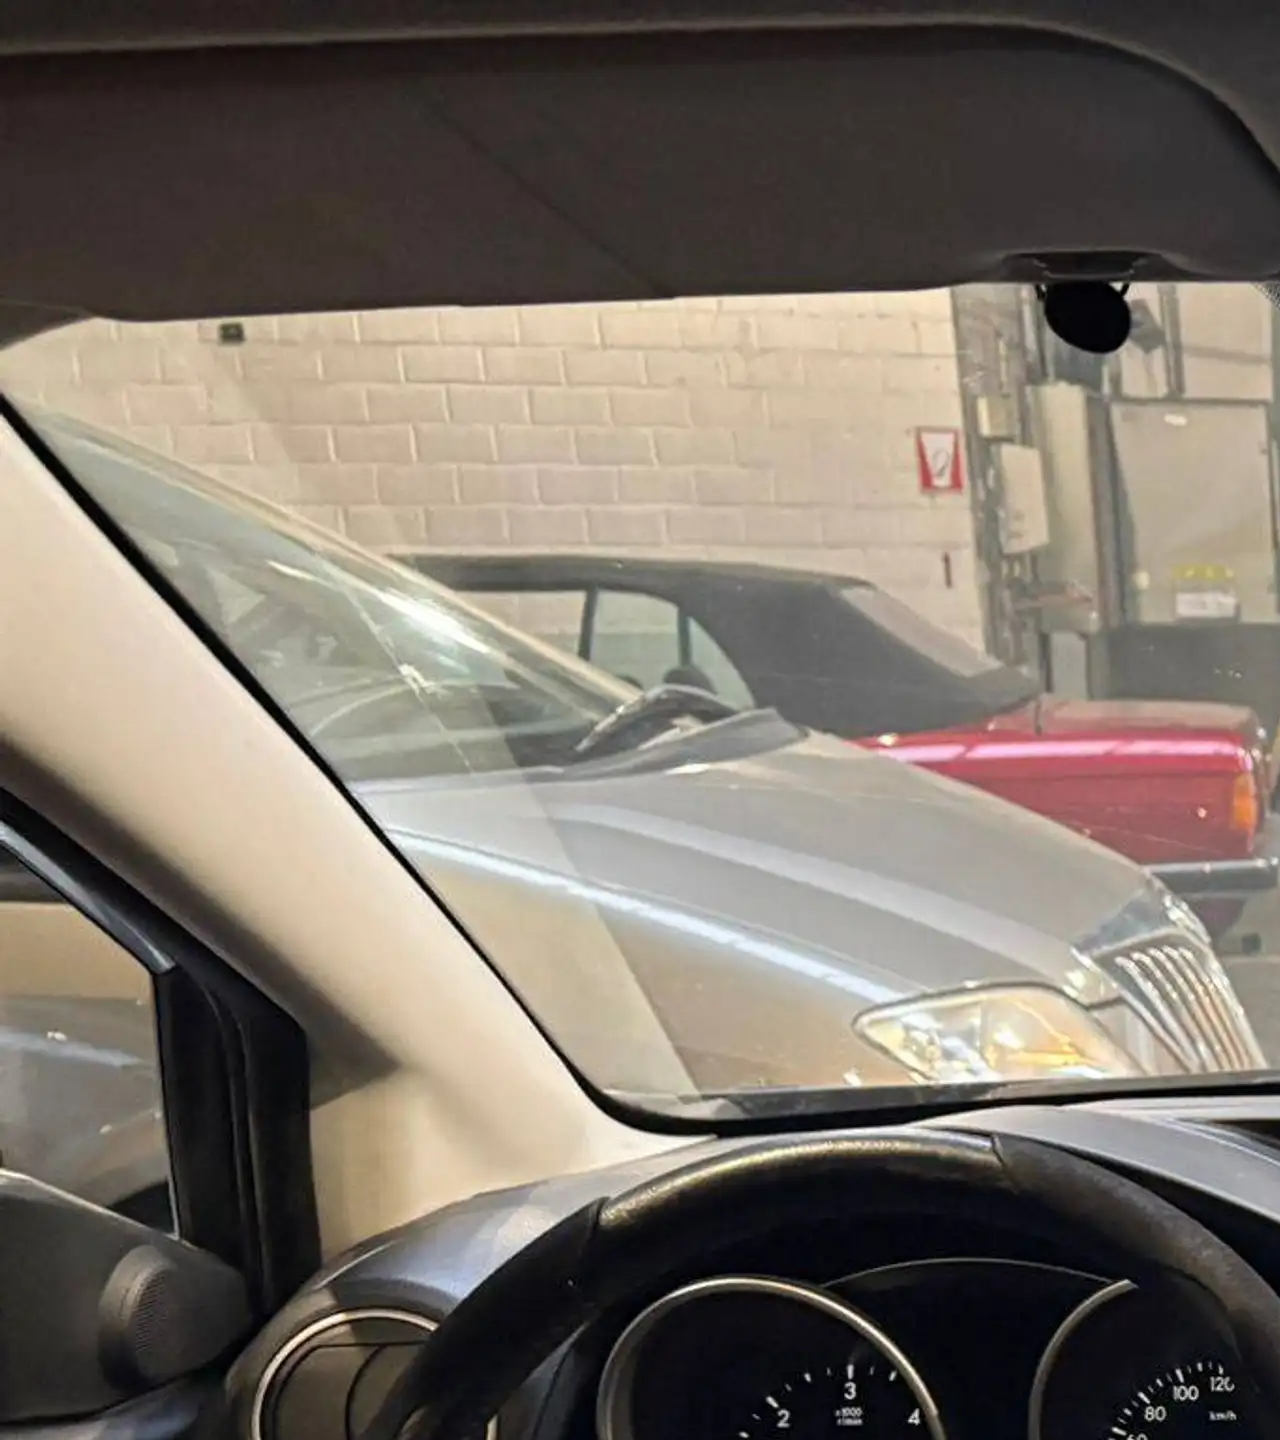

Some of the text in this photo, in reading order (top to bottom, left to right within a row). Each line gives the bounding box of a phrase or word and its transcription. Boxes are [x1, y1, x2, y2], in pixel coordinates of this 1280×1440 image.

[844, 1382, 857, 1400] 3
[1173, 1385, 1200, 1401] 100
[777, 1410, 790, 1428] 2
[908, 1408, 921, 1426] 4
[1144, 1406, 1167, 1422] 80
[1209, 1410, 1237, 1421] km/h
